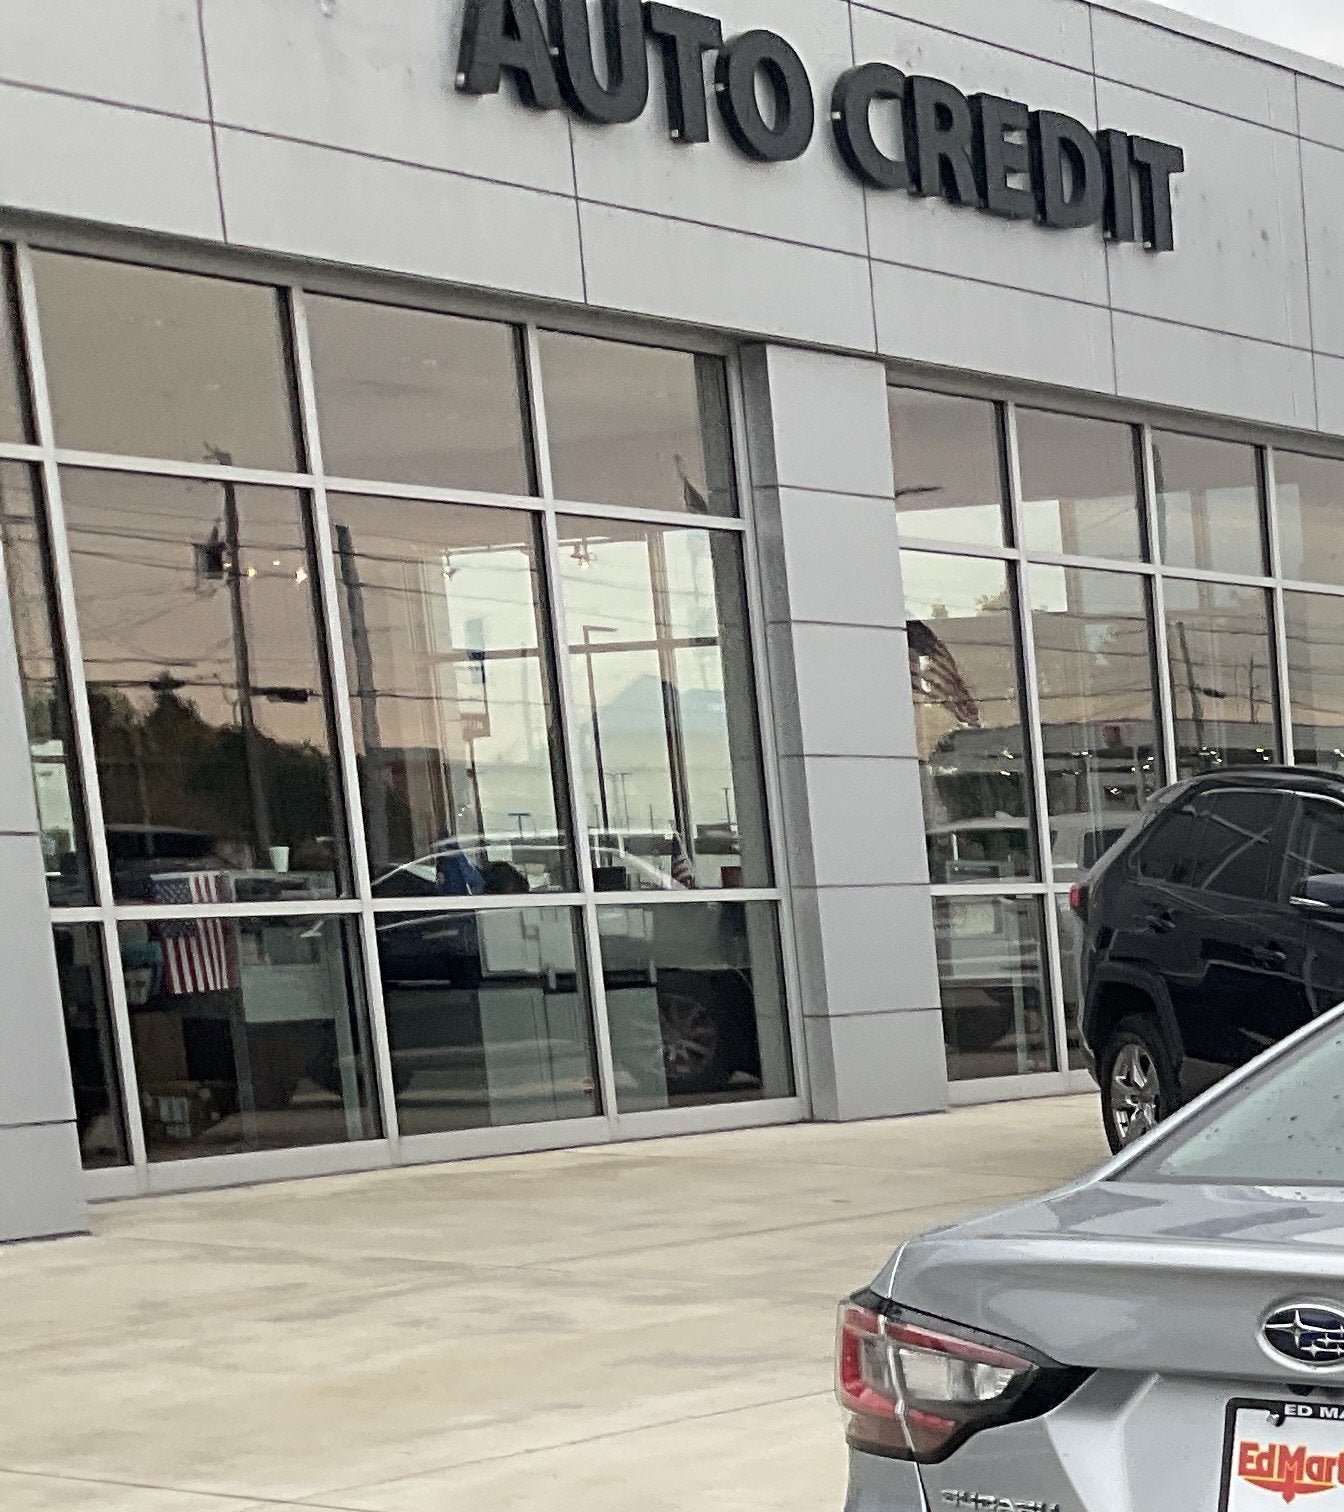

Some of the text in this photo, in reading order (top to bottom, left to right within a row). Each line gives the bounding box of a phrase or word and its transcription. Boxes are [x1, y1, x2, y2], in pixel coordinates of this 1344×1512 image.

[455, 0, 1184, 252] AUTO CREDIT
[1284, 1403, 1312, 1417] ED
